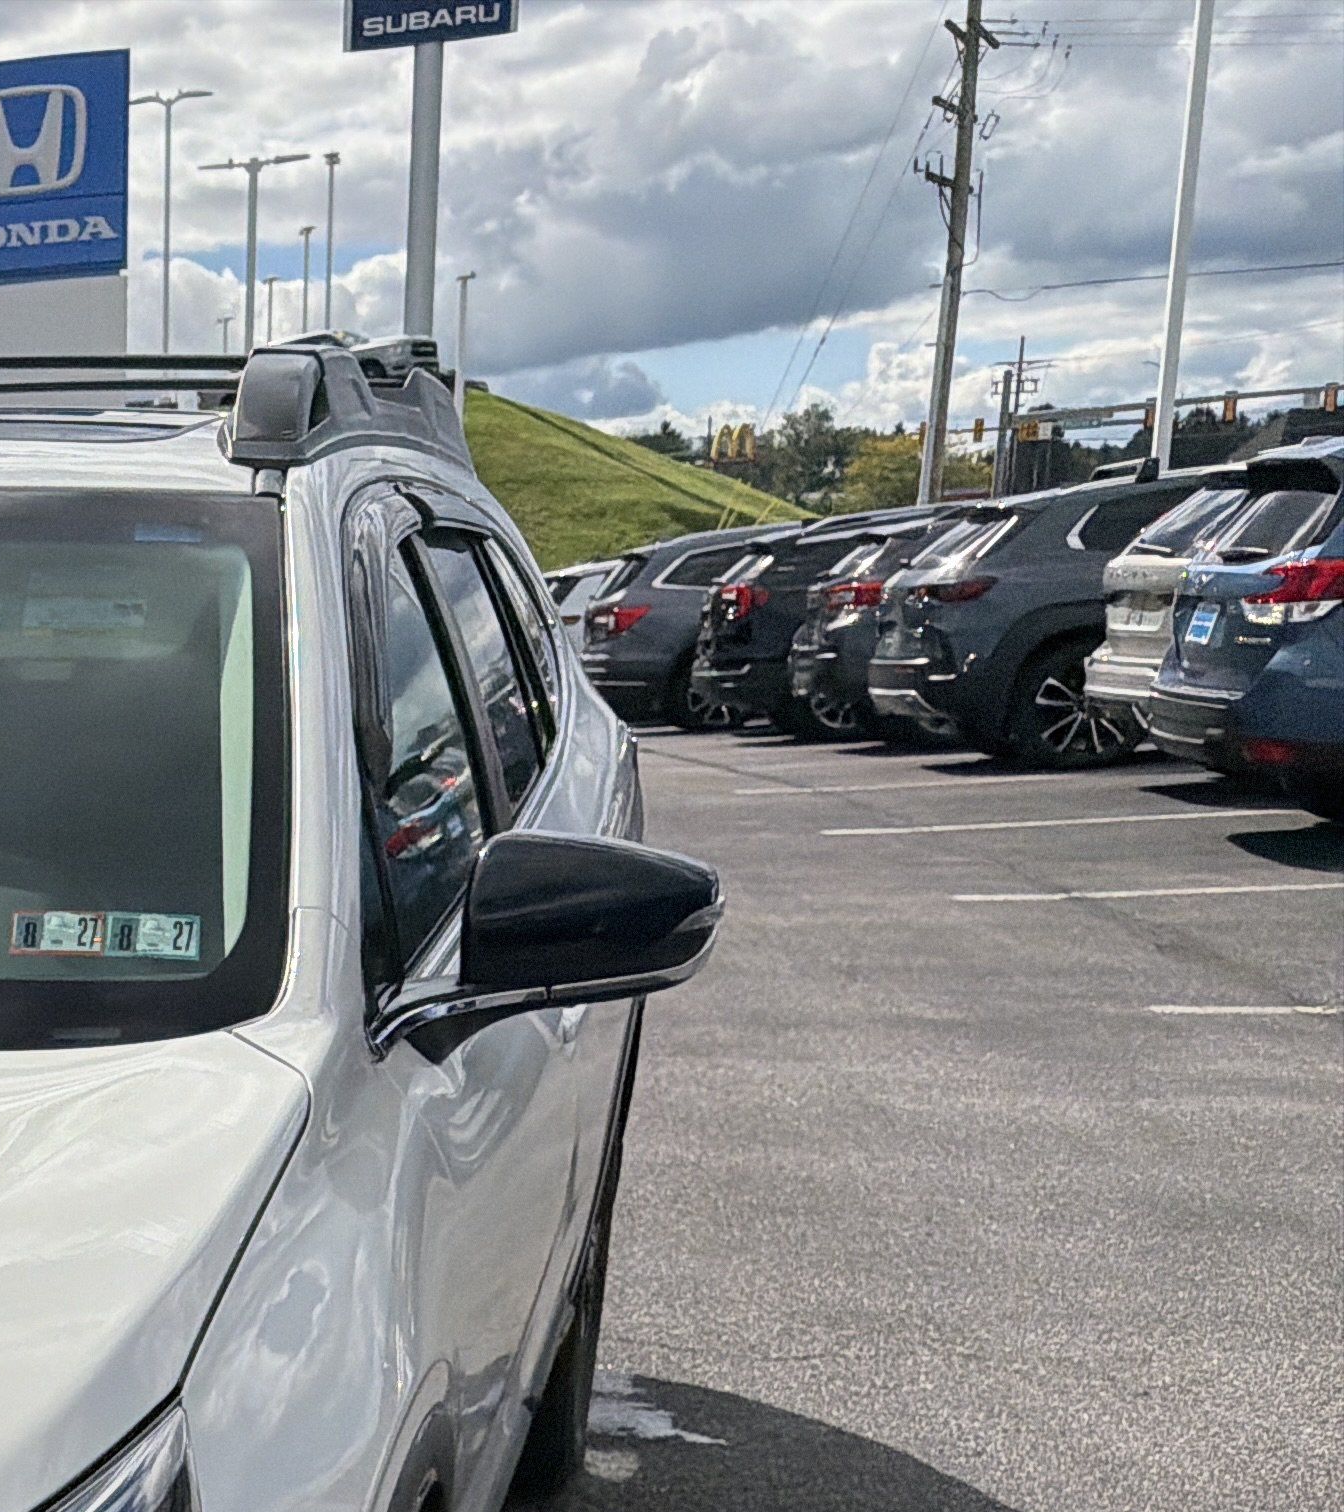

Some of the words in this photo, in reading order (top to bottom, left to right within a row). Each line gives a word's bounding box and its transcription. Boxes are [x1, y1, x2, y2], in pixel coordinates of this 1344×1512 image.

[362, 2, 501, 37] SUBARU
[76, 916, 99, 948] 27
[118, 923, 133, 951] 8
[172, 920, 195, 952] 27
